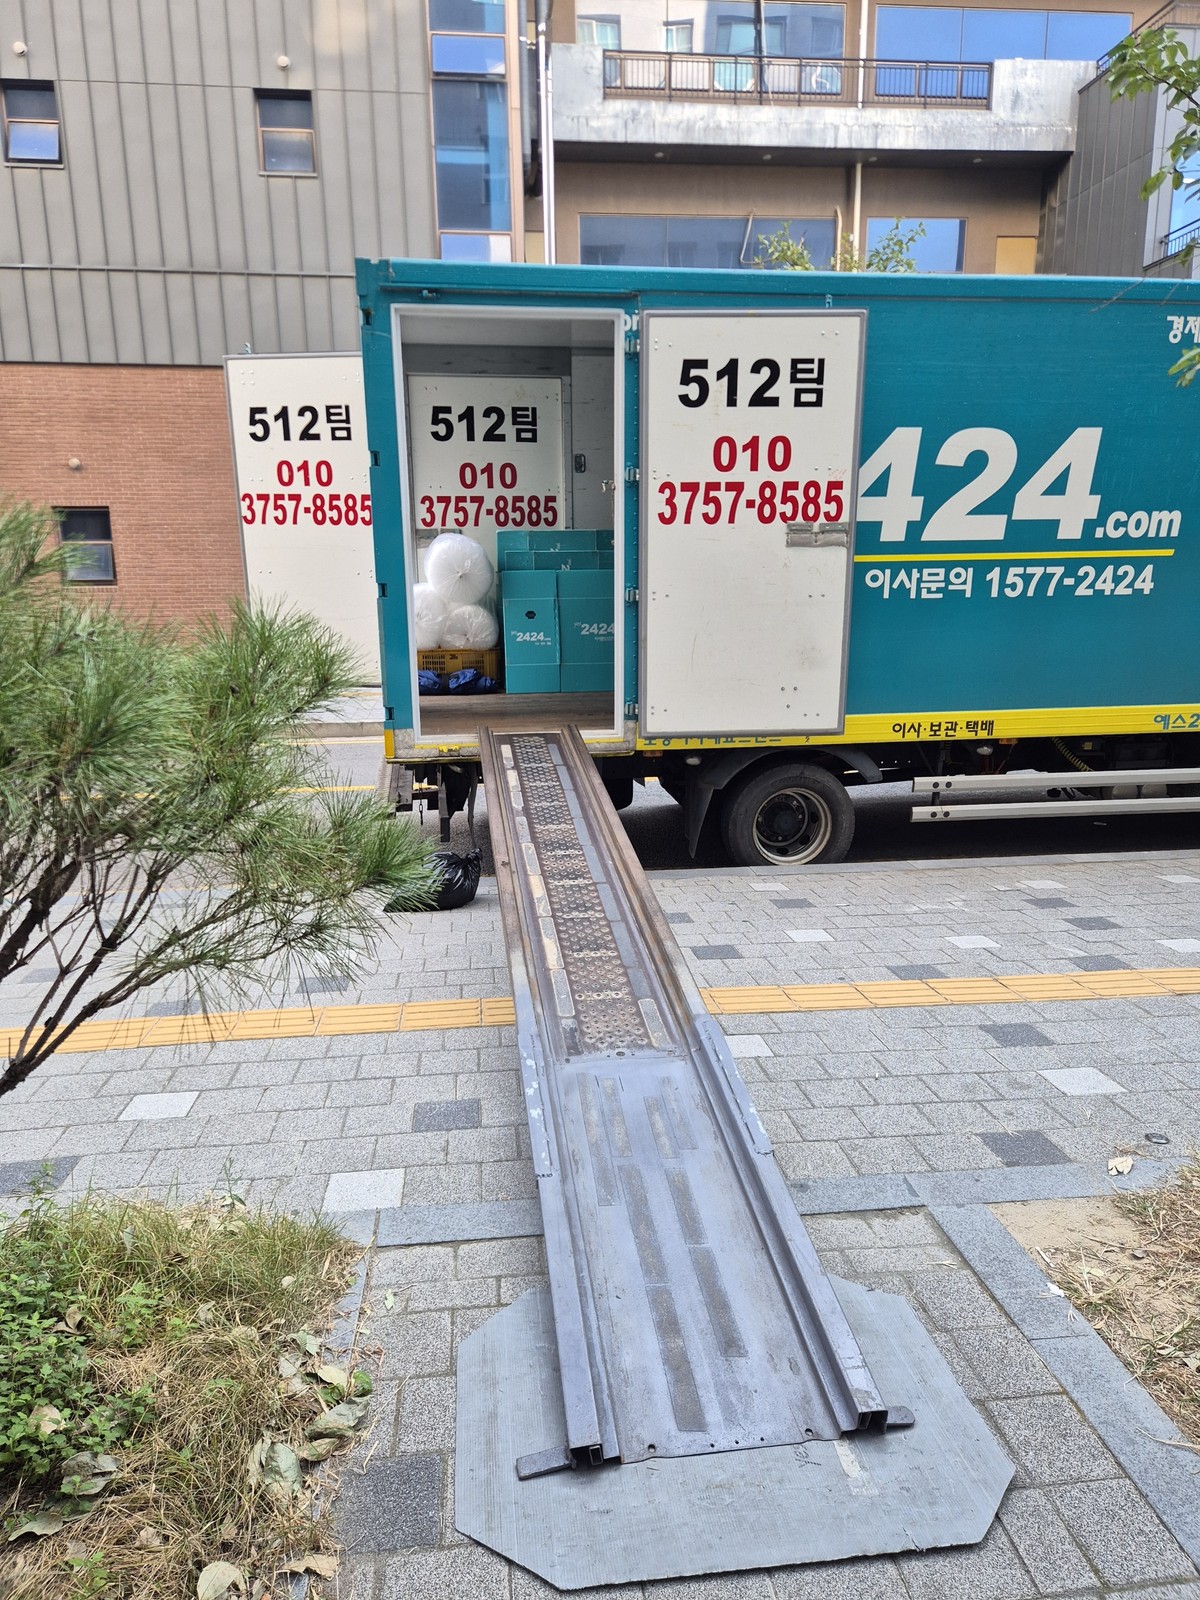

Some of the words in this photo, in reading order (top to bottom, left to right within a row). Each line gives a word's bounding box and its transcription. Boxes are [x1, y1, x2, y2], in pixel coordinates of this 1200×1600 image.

[677, 357, 825, 408] 512팀
[248, 404, 352, 442] 512팀
[430, 405, 538, 443] 512팀
[713, 435, 792, 473] 010
[276, 459, 333, 487] 010
[458, 462, 518, 490] 010
[240, 492, 373, 526] 3757-8585
[420, 495, 558, 528] 3757-8585
[657, 480, 844, 525] 3757-8585
[865, 567, 973, 599] 이사문의
[985, 564, 1154, 597] 1577-2424
